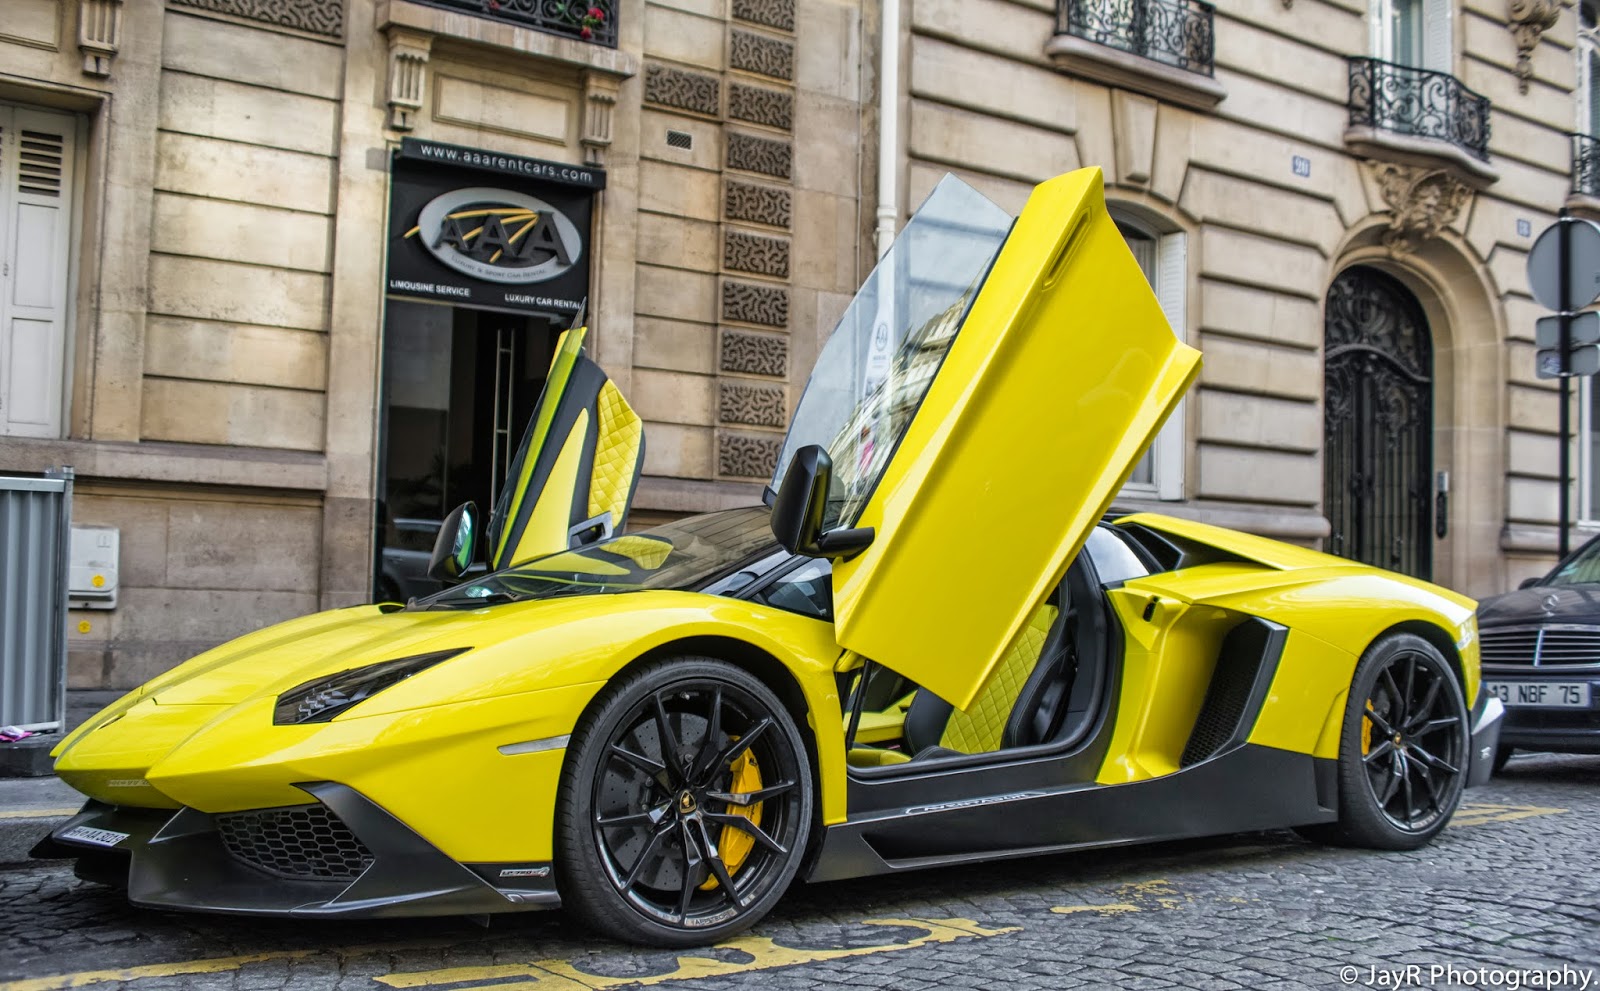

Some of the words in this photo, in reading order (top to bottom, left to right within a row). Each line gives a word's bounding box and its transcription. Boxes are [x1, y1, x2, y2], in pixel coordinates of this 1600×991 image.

[420, 144, 593, 183] www.aaarentcars.com
[432, 210, 573, 266] AAA
[390, 279, 434, 293] LIMOUSINE
[436, 285, 470, 297] SERVICE
[504, 293, 535, 304] LUXURY
[536, 297, 552, 306] CAR
[553, 299, 582, 310] RENTAL
[1518, 685, 1548, 703] NBF
[1558, 685, 1580, 704] 75
